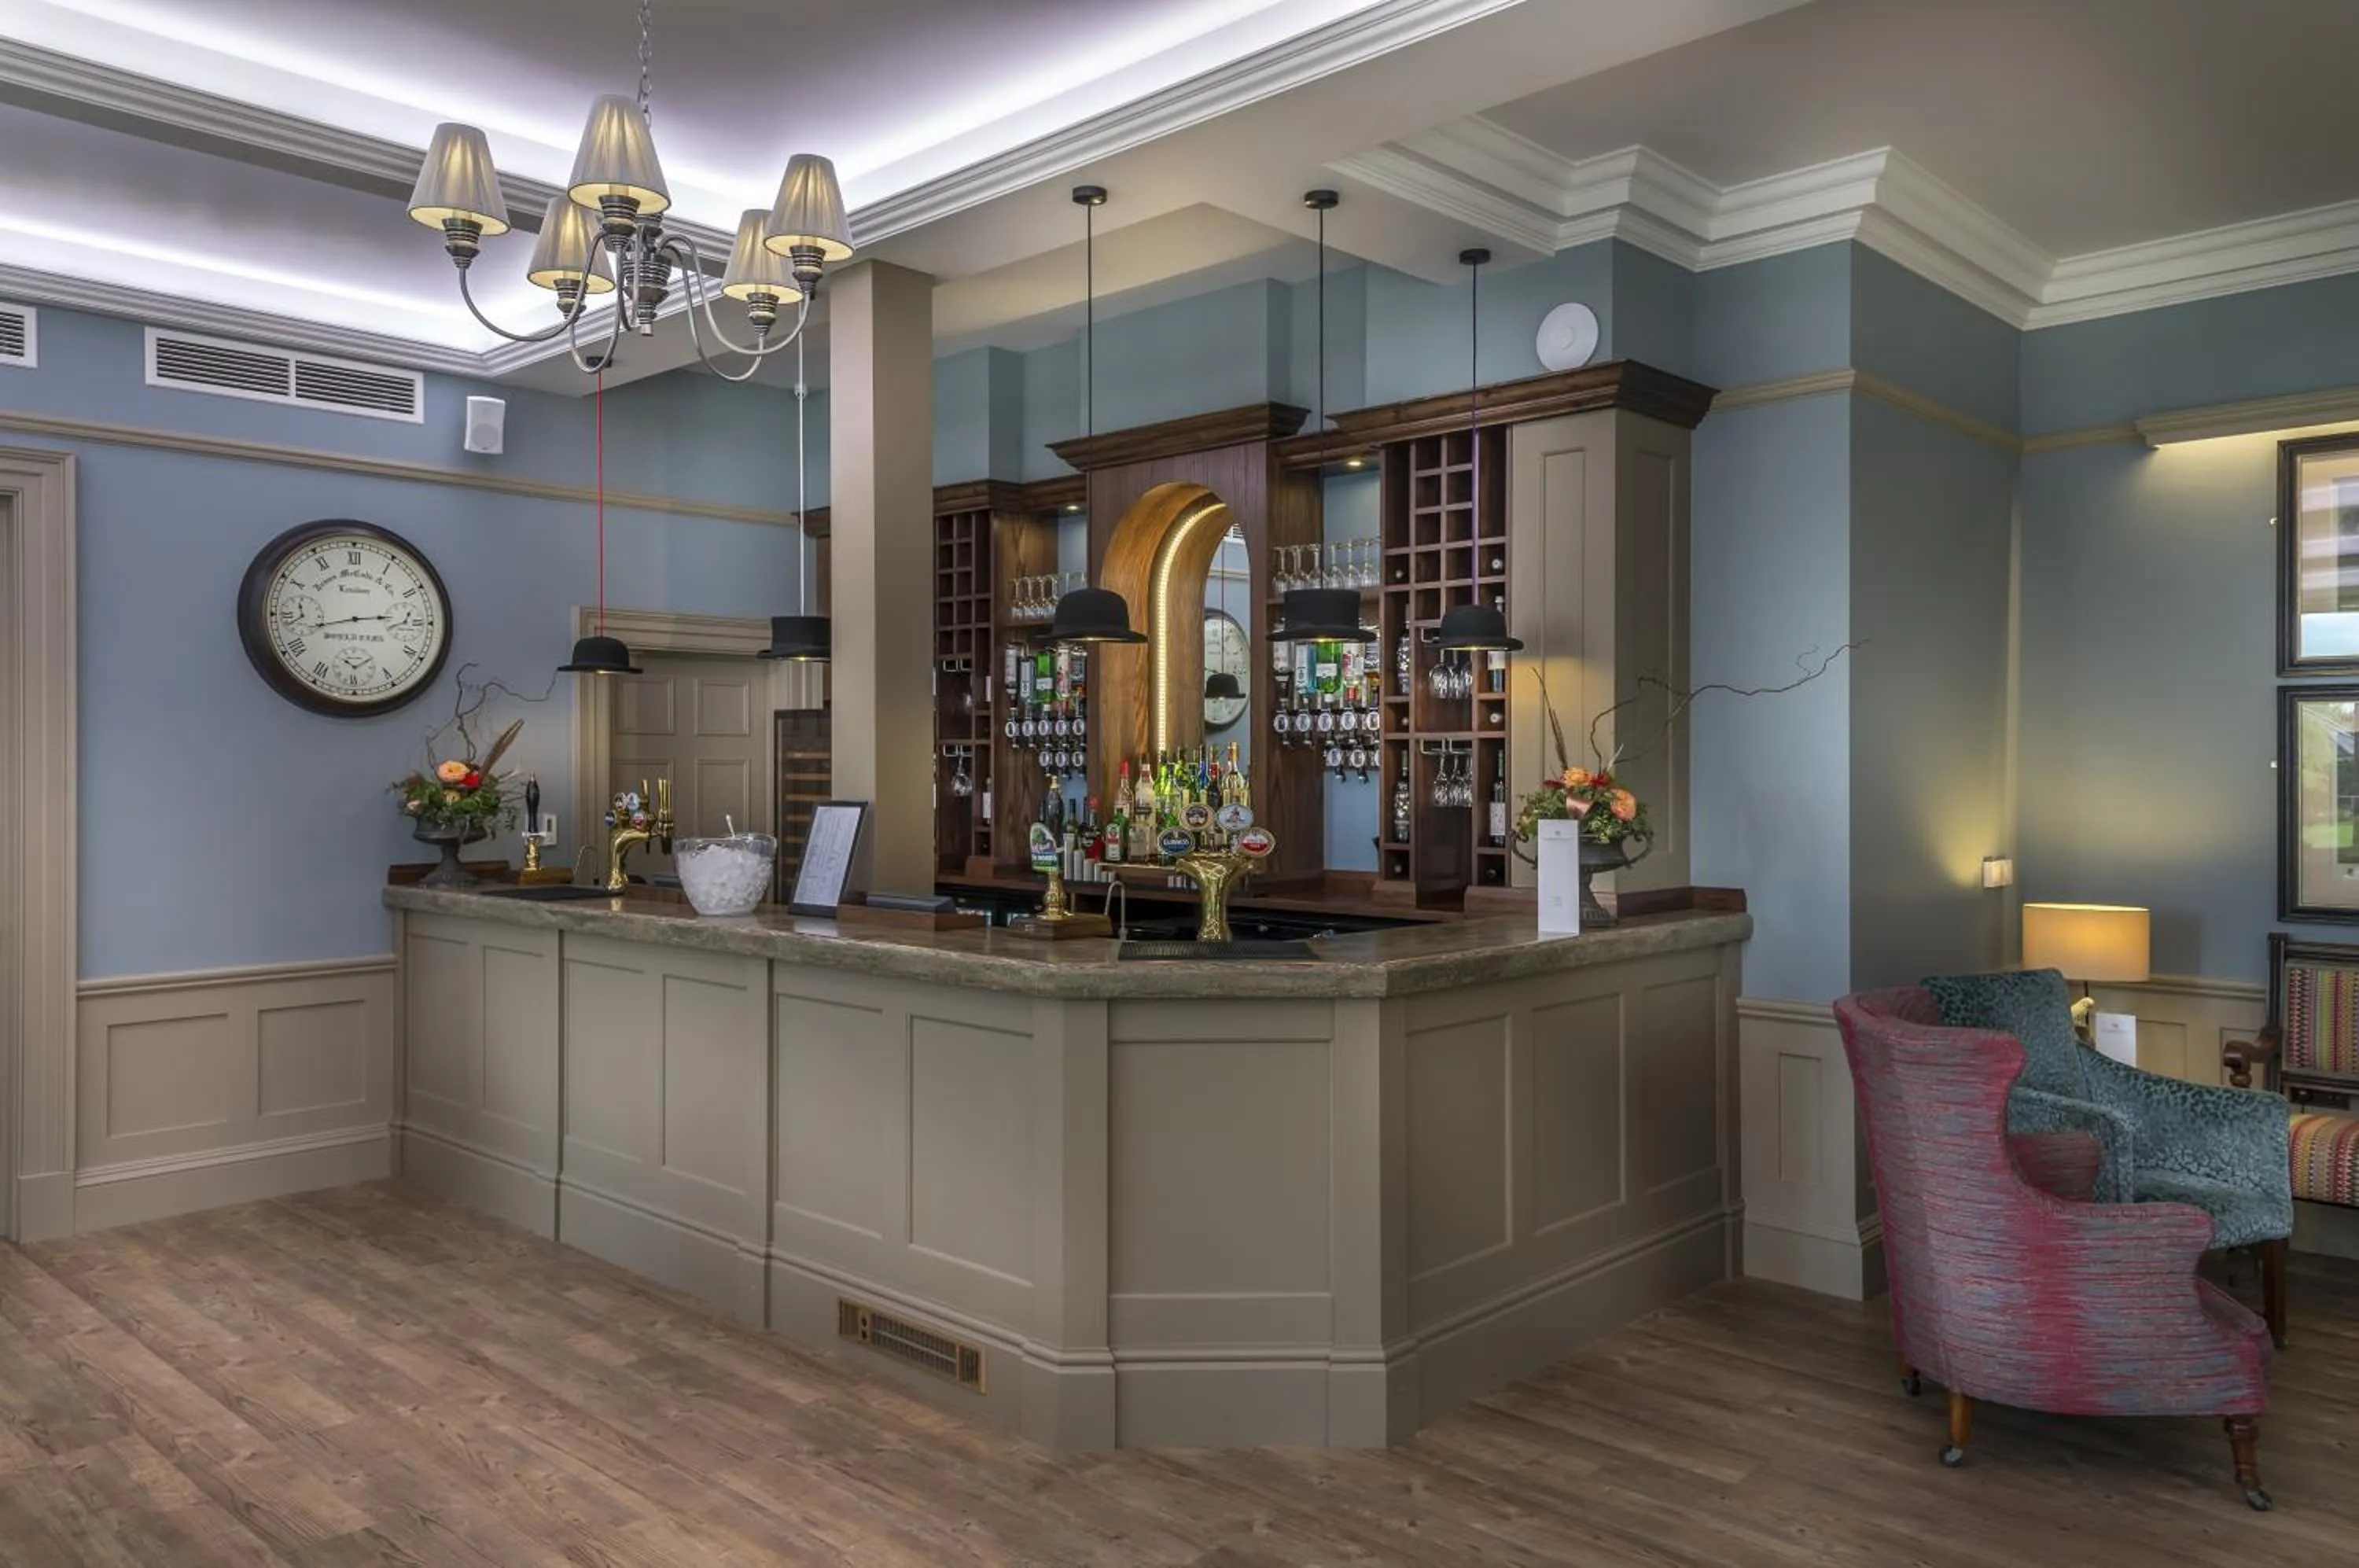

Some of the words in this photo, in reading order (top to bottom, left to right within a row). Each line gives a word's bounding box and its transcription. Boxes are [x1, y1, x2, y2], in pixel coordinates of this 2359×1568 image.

[315, 556, 329, 571] XI
[348, 551, 361, 565] XII
[403, 588, 417, 598] II
